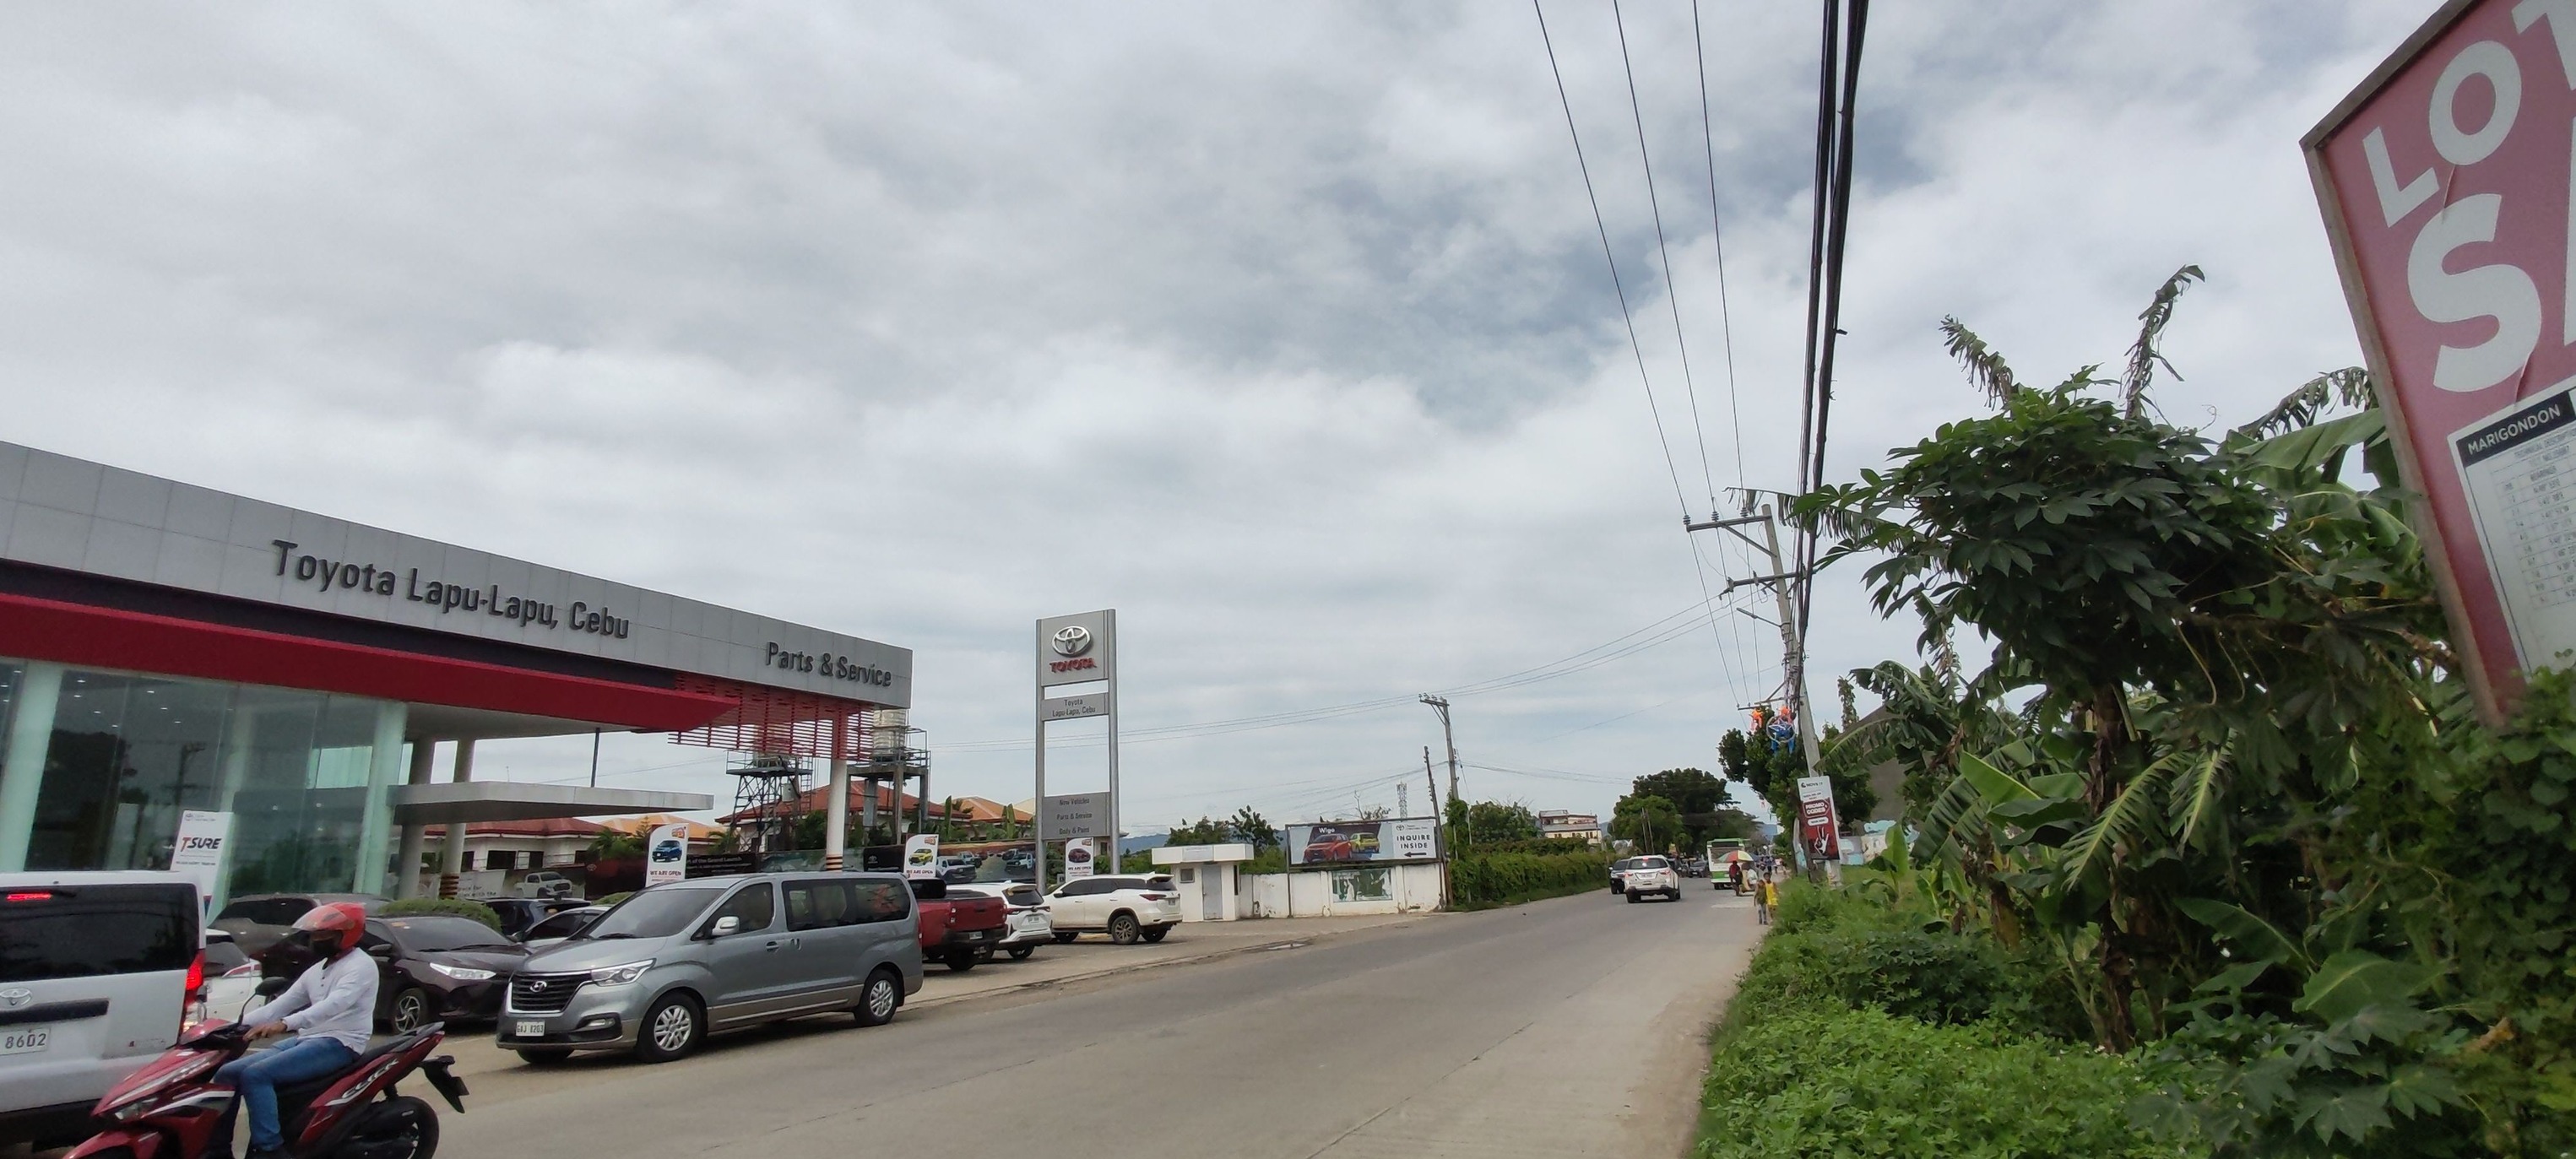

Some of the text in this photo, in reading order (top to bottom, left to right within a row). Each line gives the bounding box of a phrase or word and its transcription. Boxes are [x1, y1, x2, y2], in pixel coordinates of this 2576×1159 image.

[2407, 116, 2576, 393] S
[2467, 403, 2561, 456] MARIGONDON
[272, 539, 631, 639] Toyota Lapu-Lapu, Cebu
[766, 642, 892, 687] Parts & Service
[1049, 658, 1097, 673] TOYOTA
[1065, 699, 1083, 707] Toyota
[5, 1033, 46, 1049] 8602
